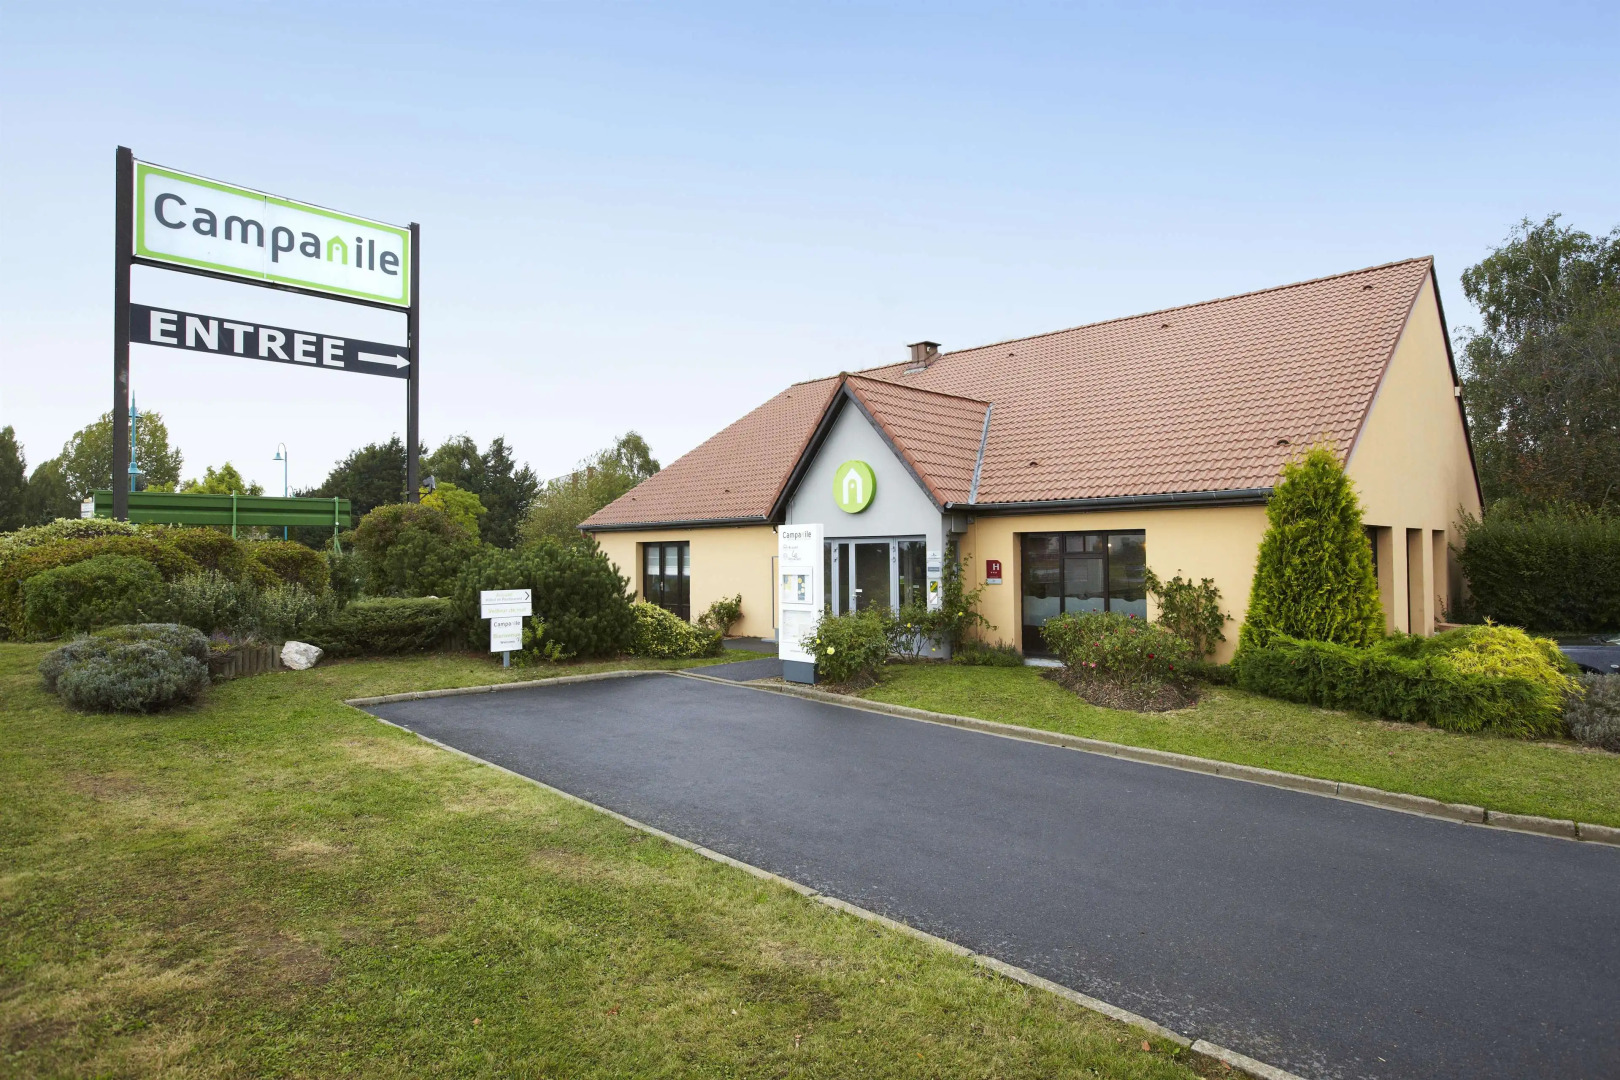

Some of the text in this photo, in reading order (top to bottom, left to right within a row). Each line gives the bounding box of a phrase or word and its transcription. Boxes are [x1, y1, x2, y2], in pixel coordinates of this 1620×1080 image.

[154, 192, 400, 276] Campanile
[150, 310, 345, 368] ENTREE
[782, 530, 812, 541] Campaile
[992, 563, 1000, 571] H
[493, 620, 521, 628] Campaile
